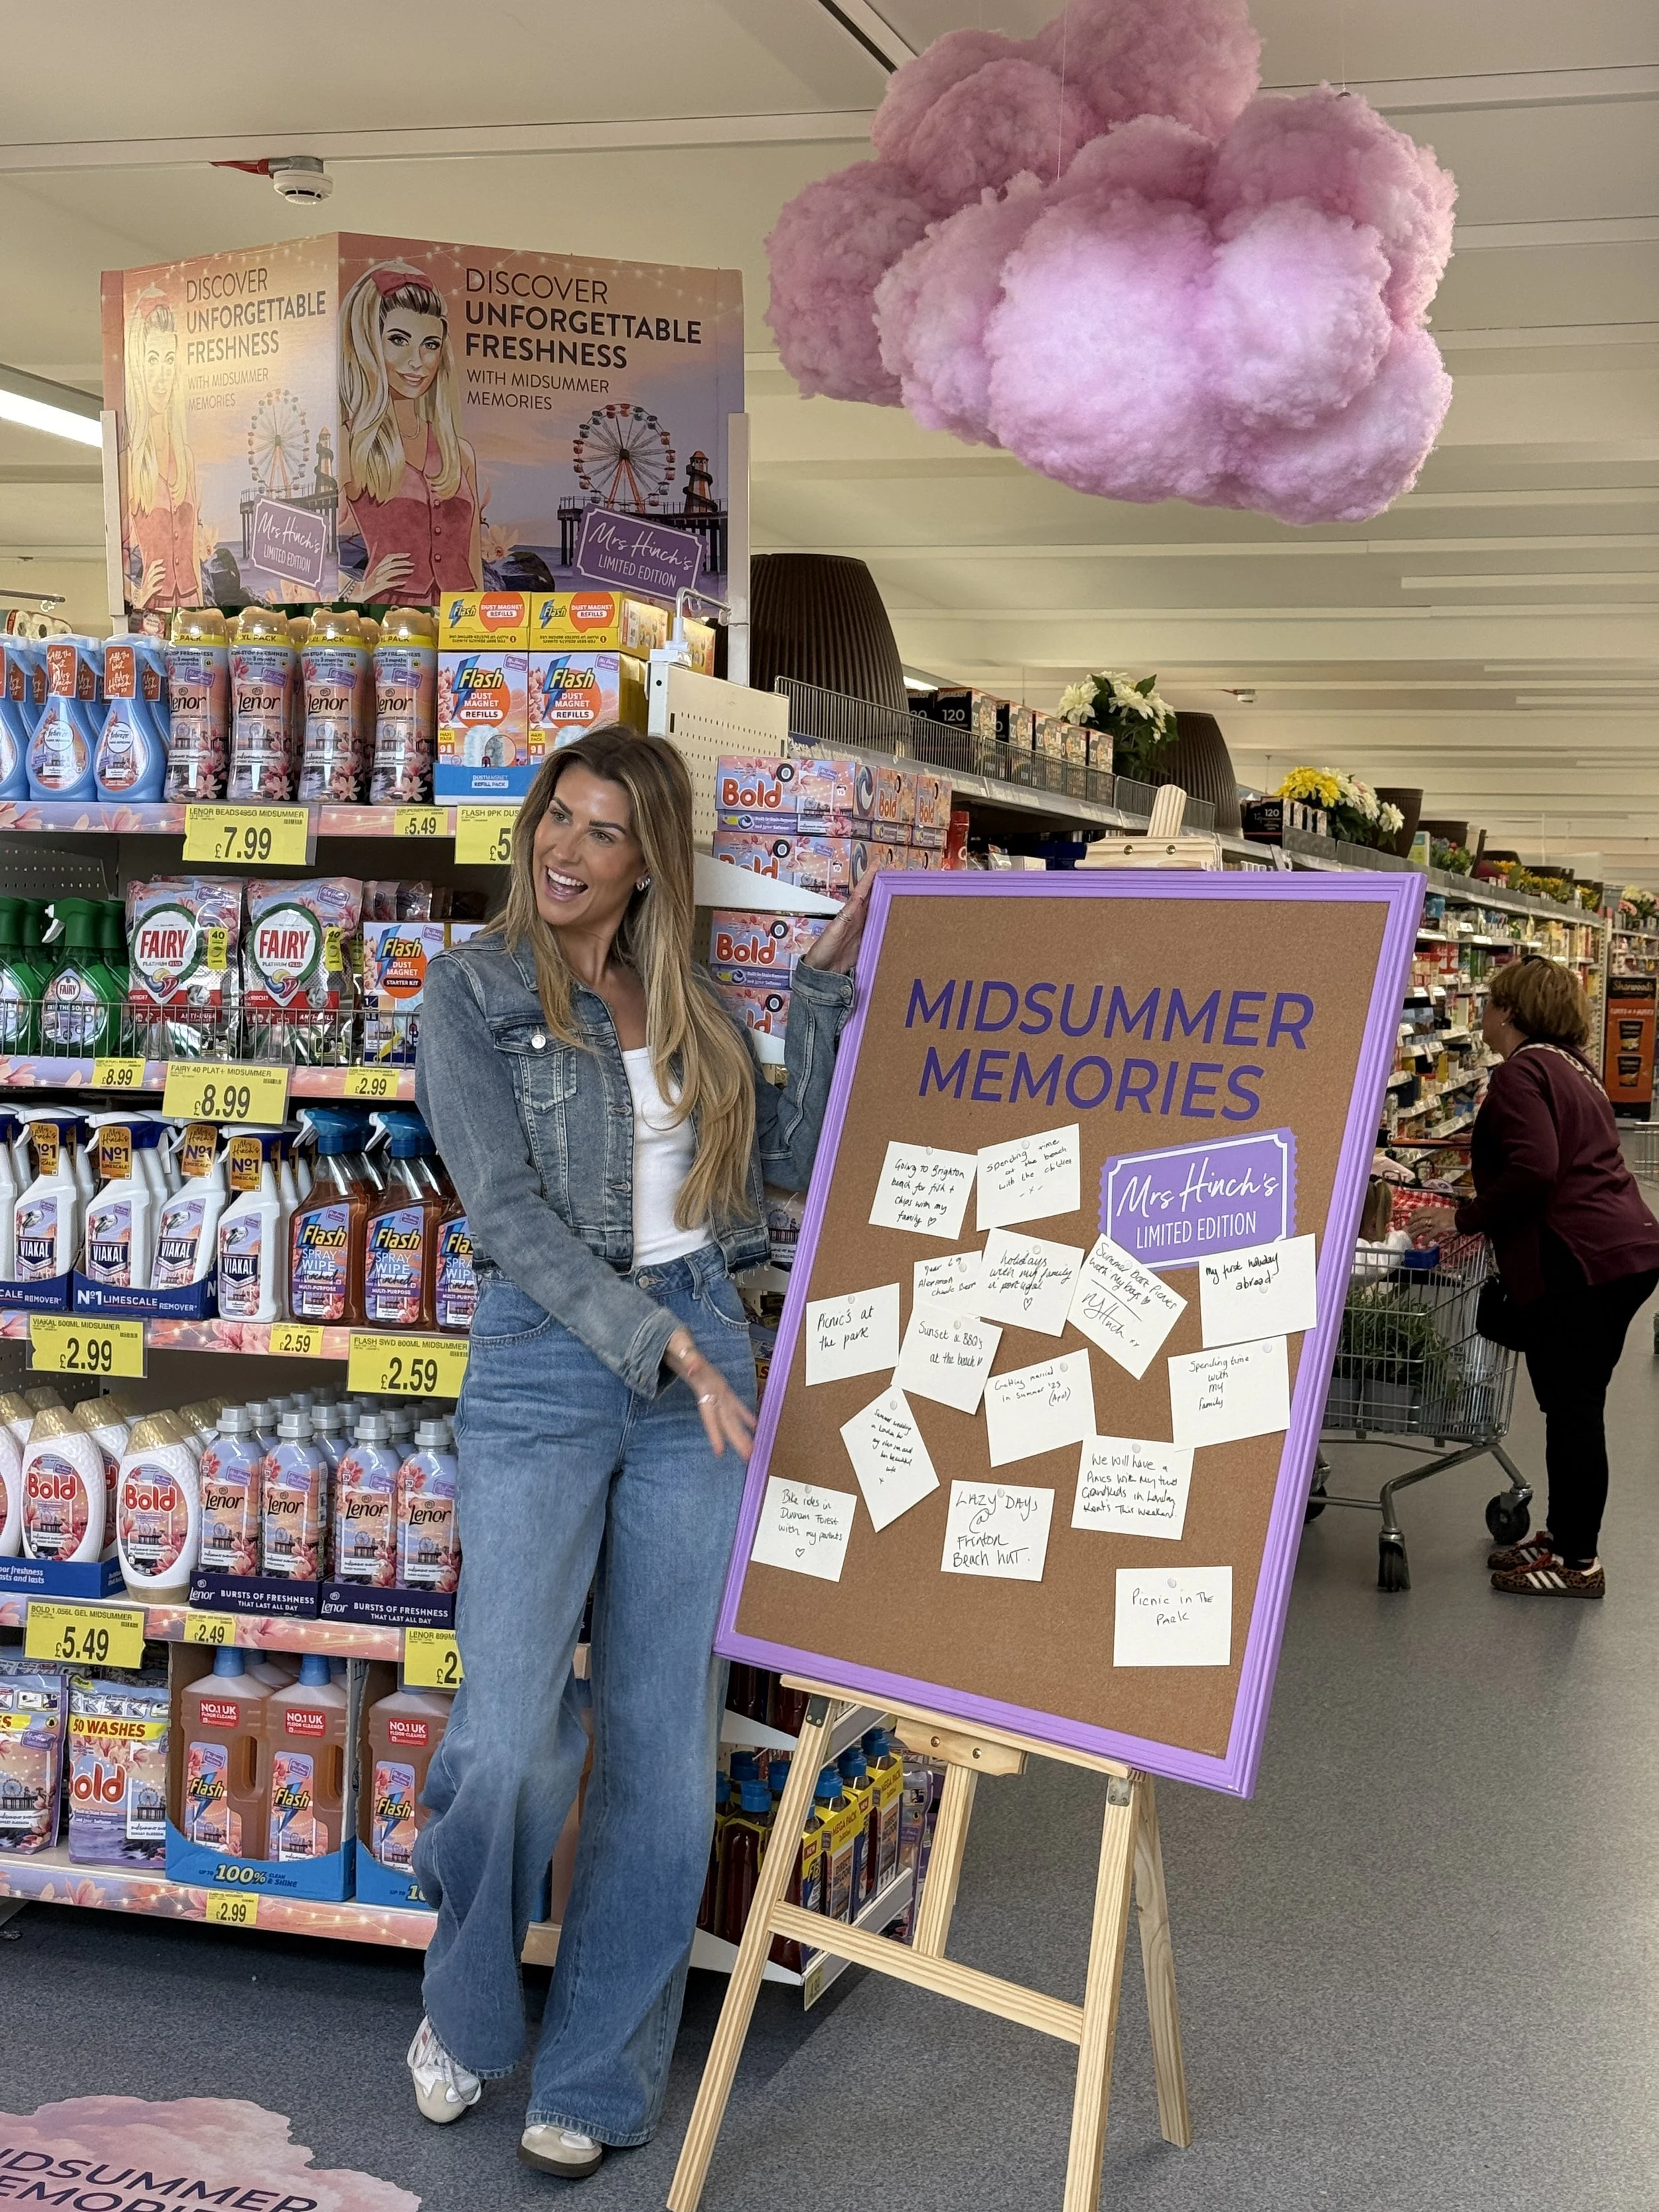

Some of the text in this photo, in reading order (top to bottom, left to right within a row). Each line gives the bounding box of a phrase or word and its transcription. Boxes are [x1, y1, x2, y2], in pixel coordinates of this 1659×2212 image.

[186, 267, 268, 303] DISCOVER
[466, 267, 609, 305] DISCOVER
[186, 290, 326, 334] UNFORGETTABLE
[465, 300, 702, 344] UNFORGETTABLE
[187, 330, 279, 365] FRESHNESS
[466, 332, 627, 369] FRESHNESS
[188, 368, 269, 390] WITH MIDSUMMER
[467, 369, 610, 394] WITH MIDSUMMER
[188, 393, 236, 411] MEMORIES
[467, 390, 553, 411] MEMORIES
[257, 512, 321, 553] Mrs Hinch's
[589, 522, 693, 571] Mrs Hinch's
[264, 544, 311, 573] LIMITED EDITION
[598, 553, 677, 588] LIMITED EDITION
[453, 605, 476, 618] Flash
[459, 668, 504, 690] Flash
[550, 668, 595, 690] Flash
[238, 696, 280, 713] Lenor
[308, 696, 348, 714] Lenor
[942, 709, 965, 721] 120
[721, 777, 783, 809] Bold
[461, 808, 501, 818] FLASH 9PK
[404, 817, 437, 835] £5.49
[215, 827, 271, 860] £7.99
[139, 930, 189, 958] FAIRY
[212, 931, 225, 940] 40
[259, 929, 311, 959] FAIRY
[382, 937, 421, 958] Flash
[715, 932, 776, 965] Bold
[386, 968, 418, 977] MAGNET
[904, 978, 1316, 1051] MIDSUMMER
[102, 1069, 133, 1085] £8.99
[228, 1068, 271, 1076] MIDSUMMER
[354, 1078, 388, 1096] £2.99
[918, 1046, 1265, 1122] MEMORIES
[194, 1084, 250, 1118] £8.99
[895, 1158, 966, 1181] Going Brighton
[912, 1184, 926, 1195] for
[929, 1182, 945, 1195] fish
[999, 1171, 1034, 1191] with the
[1116, 1157, 1279, 1218] Mrs Hinch's
[915, 1200, 947, 1215] with my
[897, 1211, 922, 1228] family
[302, 1225, 346, 1246] Flash
[376, 1228, 421, 1250] Flash
[1136, 1211, 1257, 1249] LIMITED EDITION
[21, 1241, 49, 1258] VIAKAL
[93, 1246, 123, 1263] VIAKAL
[161, 1241, 190, 1258] VIAKAL
[302, 1250, 337, 1260] SPRAY
[376, 1252, 411, 1264] SPRAY
[224, 1258, 253, 1276] VIAKAL
[302, 1259, 335, 1271] WIPE
[376, 1263, 410, 1274] WIPE
[1248, 1252, 1279, 1276] holiday
[1236, 1270, 1271, 1290] abroad
[104, 1292, 158, 1306] LIMESCALE
[860, 1305, 875, 1319] at
[33, 1318, 120, 1331] VIAKAL MIDSUMMER
[918, 1321, 949, 1341] Sunset
[279, 1333, 311, 1353] £2.59
[422, 1341, 467, 1350] MIDSUMMER
[819, 1327, 869, 1351] the park
[60, 1337, 112, 1372] £2.99
[930, 1351, 954, 1364] at the
[1189, 1355, 1250, 1372] Spending time
[381, 1357, 438, 1392] £2.59
[1030, 1366, 1053, 1380] married
[1208, 1371, 1228, 1382] with
[1092, 1453, 1156, 1471] We have
[27, 1473, 77, 1500] Bold
[124, 1483, 177, 1511] Bold
[205, 1494, 244, 1511] Lenor
[267, 1495, 304, 1514] Lenor
[803, 1496, 820, 1507] rides
[956, 1491, 997, 1515] LAZY
[346, 1502, 388, 1519] Lenor
[409, 1505, 451, 1525] Lenor
[969, 1508, 990, 1534] @
[806, 1530, 816, 1546] my
[953, 1550, 989, 1568] Beach
[13, 1575, 44, 1584] and lasts
[189, 1587, 215, 1601] Lenor
[221, 1590, 315, 1605] BURSTS OF FRESHNESS
[1133, 1587, 1192, 1605] Picnic in
[74, 1609, 88, 1618] GEL
[90, 1611, 132, 1621] MIDSUMMER
[321, 1600, 348, 1615] Lenor
[354, 1603, 449, 1618] BURSTS OF FRESHNESS
[54, 1626, 109, 1661] £5.49
[194, 1624, 225, 1644] £2.49
[200, 1703, 236, 1716] NO.1 UK
[287, 1713, 323, 1725] NO.1 UK
[73, 1719, 146, 1737] 50 WASHES
[390, 1720, 426, 1733] NO.1 UK
[189, 1778, 224, 1798] Flash
[275, 1789, 311, 1809] Flash
[377, 1799, 412, 1819] Flash
[214, 1864, 267, 1884] 100%
[216, 1901, 246, 1923] £2.99
[0, 2148, 318, 2212] IDSUMMER
